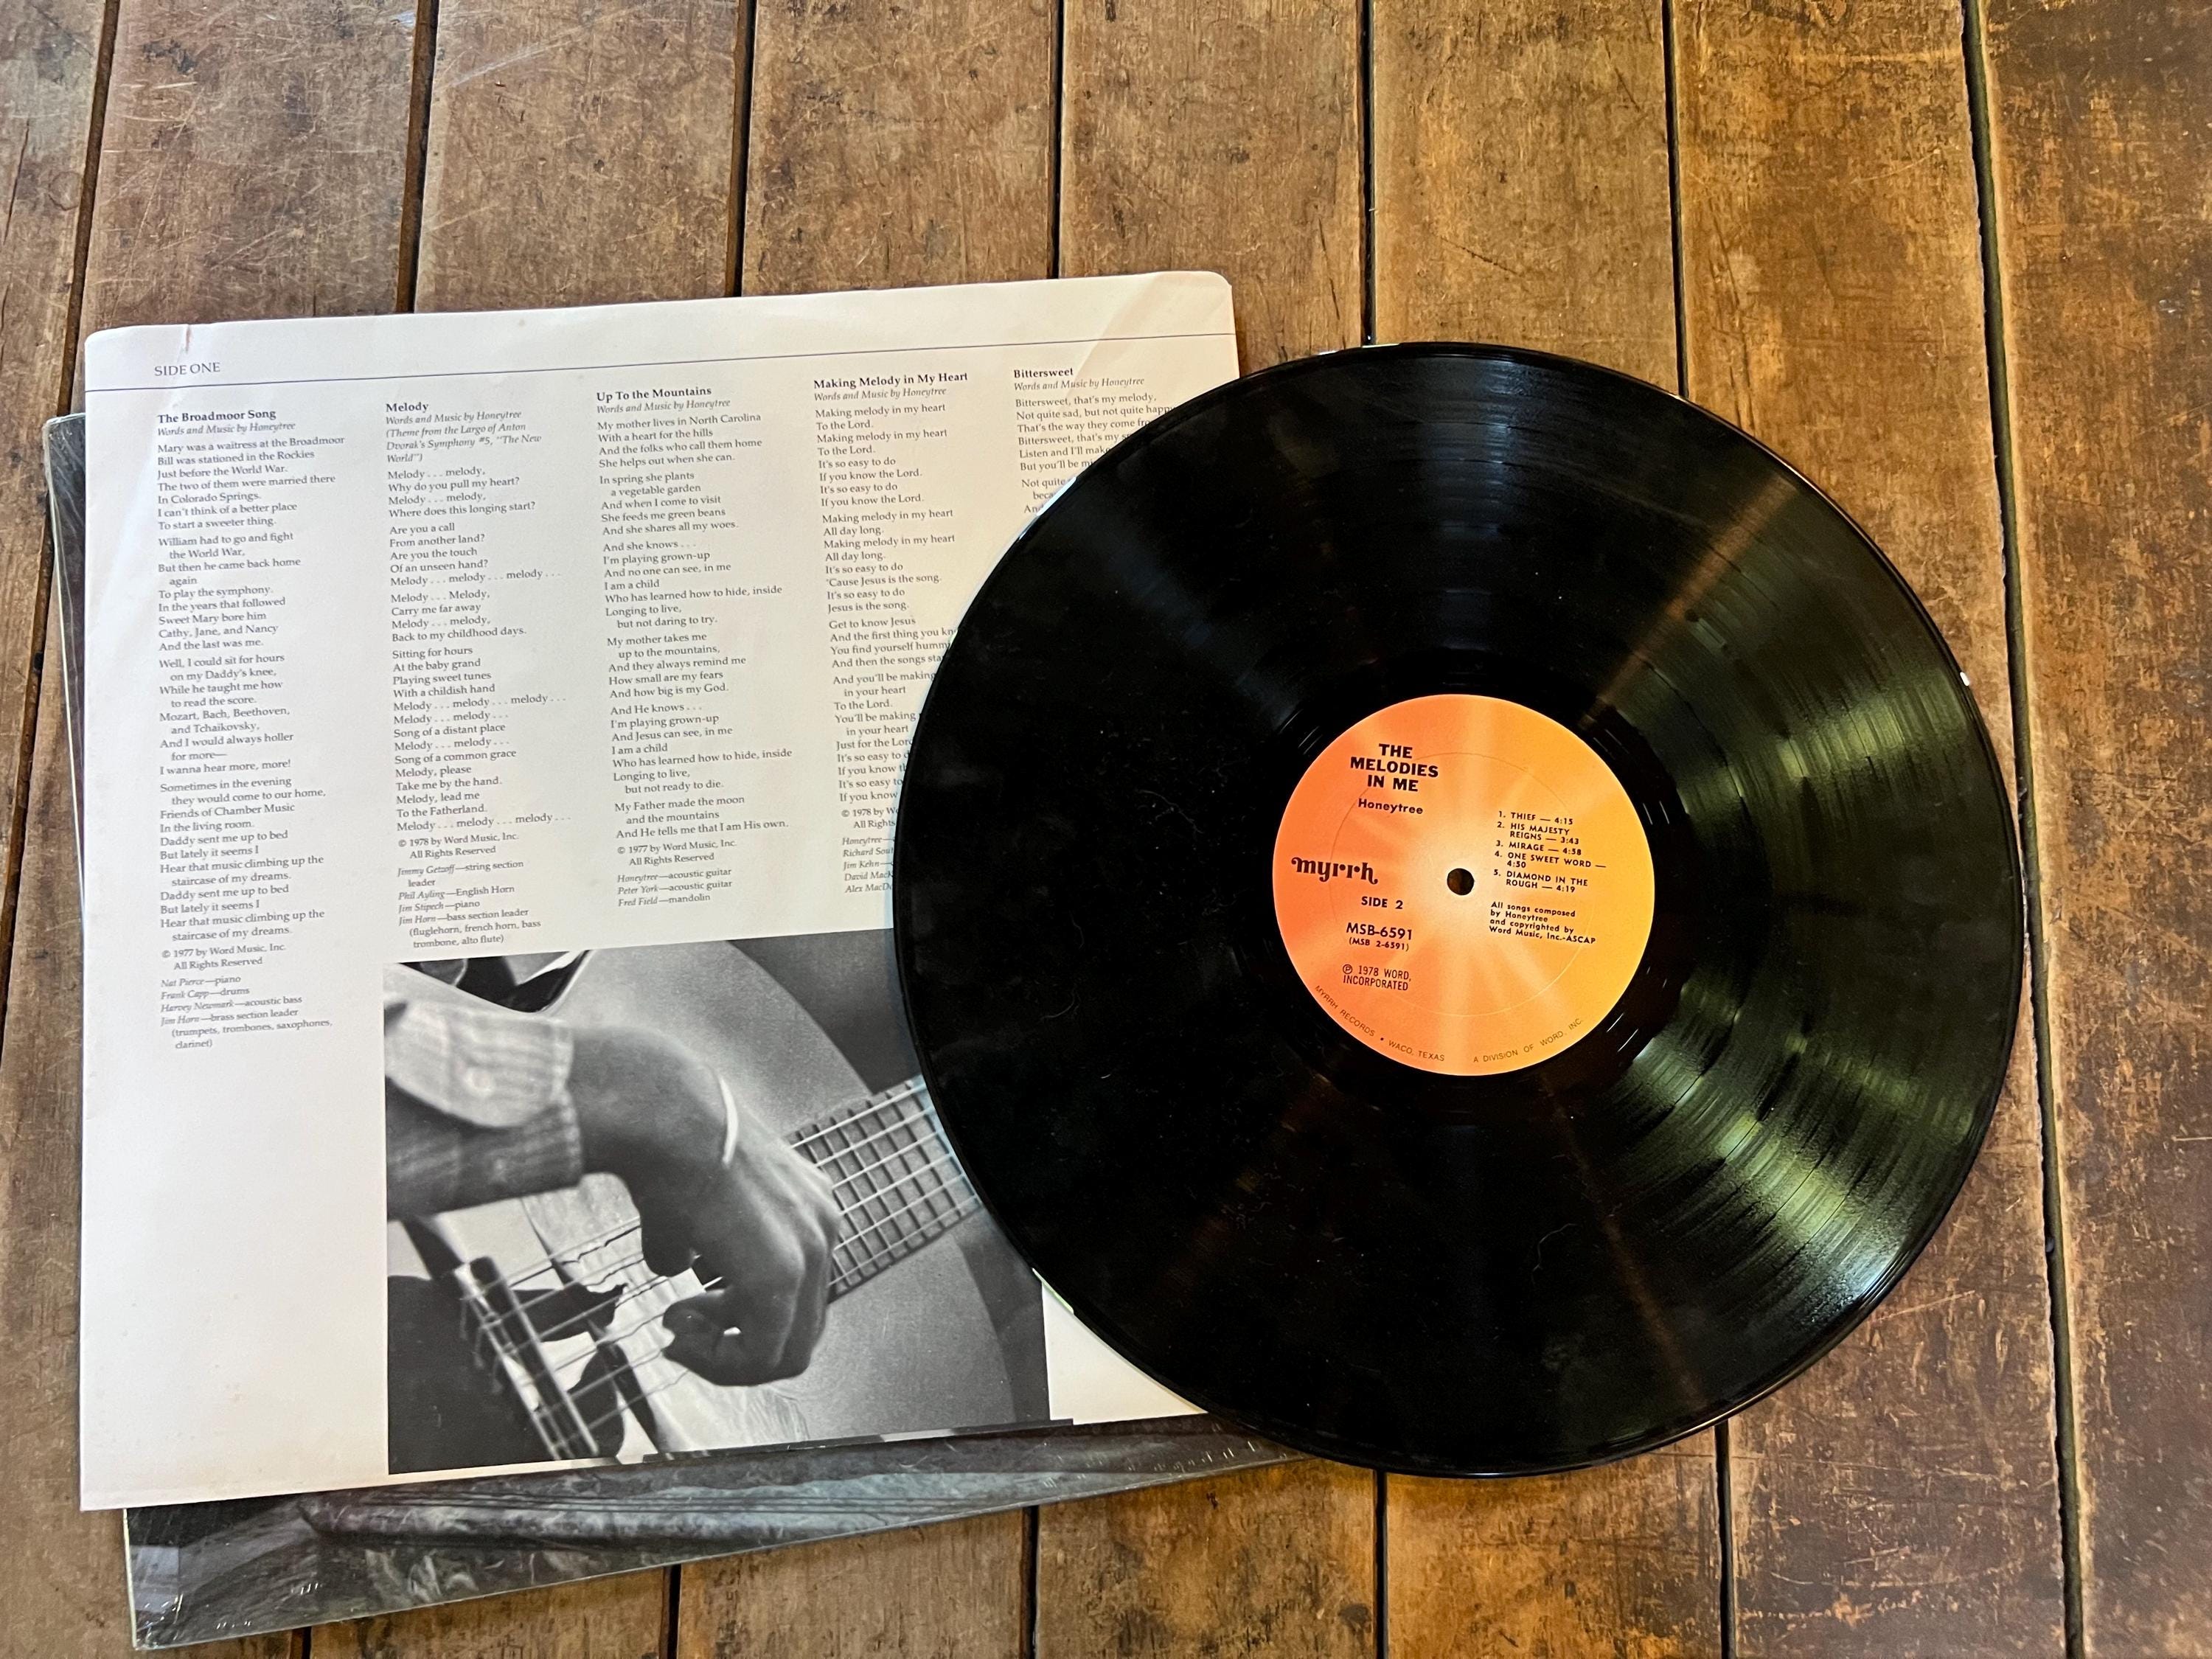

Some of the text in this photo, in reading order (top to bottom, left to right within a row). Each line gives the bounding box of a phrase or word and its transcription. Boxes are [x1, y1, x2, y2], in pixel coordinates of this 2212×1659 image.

[154, 362, 220, 377] SIDE ONE
[1013, 367, 1073, 378] Bittersweet
[814, 372, 967, 390] Making Melody in My Heart
[1014, 378, 1144, 391] Words and Music by Honeytree
[597, 386, 712, 404] Up To the Mountains
[814, 387, 947, 401] Words and Music by Honeytree
[1015, 392, 1157, 408] Bittersweet, that's my melody,
[386, 402, 428, 414] Melody
[597, 400, 731, 414] Words and Music by Honeytree
[815, 403, 945, 420] Making melody in my heart
[157, 409, 276, 423] The Broadmoor Song
[597, 413, 761, 433] My mother lives in North Carolina
[158, 444, 184, 455] Mary
[216, 441, 257, 450] waitress
[260, 440, 269, 448] at
[271, 438, 288, 448] the
[289, 436, 345, 446] Broadmoor
[388, 476, 520, 494] Why do you pull my heart?
[603, 552, 710, 567] I'm playing grown-up
[391, 607, 420, 617] Carry
[439, 604, 453, 613] far
[454, 605, 481, 613] away
[829, 617, 916, 630] Get to know Jesus
[392, 626, 526, 642] Back to my childhood days.
[159, 707, 290, 722] Mozart, Bach, Beethoven,
[1378, 743, 1413, 759] THE
[1350, 757, 1439, 778] MELODIES
[1367, 774, 1419, 792] IN ME
[160, 803, 296, 819] Friends of Chamber Music
[1358, 798, 1423, 815] Honeytree
[1510, 812, 1536, 821] THIEF
[1554, 817, 1573, 825] 4:15
[1497, 821, 1570, 835] 2. HIS MAJESTY
[1510, 831, 1542, 841] REIGNS
[1560, 836, 1579, 845] 3:43
[409, 846, 496, 859] All Rights Reserved
[1509, 841, 1544, 852] MIRAGE
[1562, 847, 1582, 856] 4:58
[1506, 860, 1526, 869] 4:50
[1507, 852, 1526, 860] ONE
[1530, 854, 1559, 864] SWEET
[1563, 858, 1591, 868] WORD
[1291, 857, 1378, 885] myrrh
[1493, 869, 1588, 886] 5. DIAMOND IN THE
[617, 886, 639, 895] Peter
[706, 880, 732, 891] guitar
[1506, 879, 1538, 889] ROUGH
[618, 897, 636, 907] Fred
[1361, 896, 1403, 910] SIDE 2
[1491, 901, 1576, 917] All songs composed
[1490, 909, 1548, 922] by Honeytree
[1346, 922, 1412, 940] MSB-6591
[1489, 925, 1512, 934] Word
[1515, 929, 1543, 939] Music,
[1510, 921, 1559, 932] copyrighted
[1564, 925, 1574, 934] by
[1349, 936, 1409, 952] (MSB 2-6591)
[1358, 965, 1379, 977] 1978
[1382, 968, 1411, 982] WORD,
[1343, 975, 1408, 991] INCORPORATED
[1315, 985, 1338, 1009] MYRRH
[1340, 1009, 1375, 1036] RECORDS
[1419, 1051, 1445, 1061] TEXAS
[1483, 1049, 1518, 1062] DIVISION
[1523, 1044, 1534, 1053] OF
